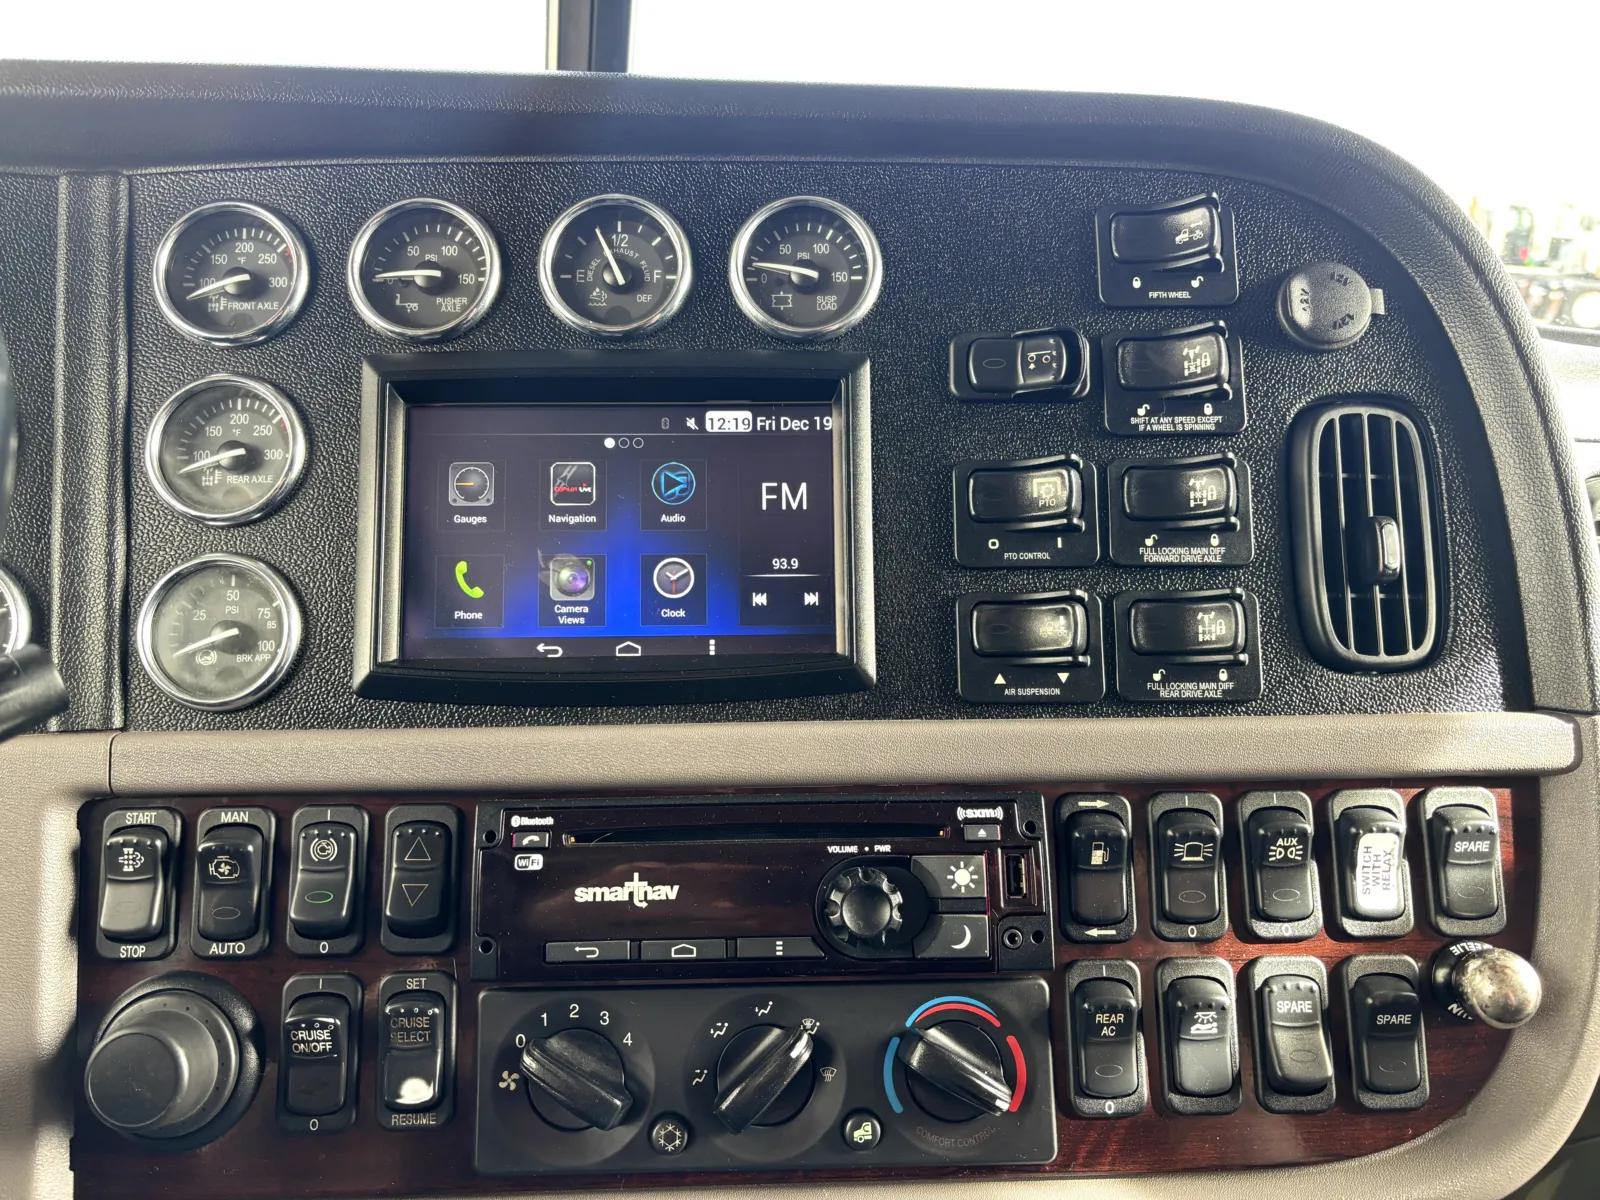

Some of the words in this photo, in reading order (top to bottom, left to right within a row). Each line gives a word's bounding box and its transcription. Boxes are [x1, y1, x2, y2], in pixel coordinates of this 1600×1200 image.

[611, 234, 628, 247] 1/2
[236, 242, 254, 253] 200
[408, 246, 420, 256] 50
[441, 246, 458, 256] 100
[779, 244, 791, 254] 50
[813, 243, 830, 254] 100
[211, 254, 227, 264] 150
[258, 254, 277, 264] 250
[587, 258, 600, 281] DIESEL
[458, 274, 474, 284] 150
[576, 270, 585, 282] E
[654, 270, 662, 283] F
[761, 273, 767, 283] 0
[832, 272, 848, 282] 150
[269, 278, 287, 287] 300
[230, 414, 249, 425] 200
[708, 418, 751, 430] 12:19
[757, 417, 776, 430] Fri
[780, 417, 810, 430] Dec
[814, 417, 832, 430] 19
[205, 426, 222, 436] 150
[253, 426, 272, 436] 250
[193, 450, 210, 461] 100
[264, 450, 283, 460] 300
[252, 475, 273, 483] AXLE
[762, 482, 807, 510] FM
[1039, 499, 1056, 507] PTO
[454, 515, 487, 525] Gauges
[549, 514, 596, 524] Navigation
[661, 514, 686, 522] Audio
[772, 558, 799, 569] 93.9
[226, 590, 240, 601] 50
[226, 606, 240, 614] PSI
[257, 608, 271, 619] 75
[555, 605, 589, 613] Camera
[661, 609, 686, 618] Clock
[193, 610, 206, 620] 25
[455, 611, 483, 620] Phone
[558, 616, 585, 624] Views
[258, 640, 275, 651] 100
[126, 812, 157, 823] START
[221, 812, 248, 822] MAN
[1276, 838, 1298, 846] AUX
[1454, 841, 1490, 853] SPARE
[1362, 846, 1372, 895] SWITCH
[1372, 854, 1382, 887] WITH
[1382, 850, 1393, 891] RELAY
[574, 872, 680, 908] smartnav
[120, 946, 146, 958] STOP
[209, 942, 246, 955] AUTO
[406, 978, 426, 989] SET
[570, 1004, 579, 1018] 2
[1277, 1001, 1312, 1013] SPARE
[390, 1017, 430, 1029] CRUISE
[540, 1012, 548, 1026] 1
[600, 1011, 610, 1025] 3
[1096, 1014, 1124, 1024] REAR
[1376, 1015, 1412, 1025] SPARE
[291, 1030, 331, 1040] CRUISE
[1101, 1026, 1116, 1036] AC
[390, 1031, 431, 1043] SELECT
[516, 1034, 526, 1048] 0
[623, 1032, 632, 1046] 4
[292, 1042, 333, 1053] ON/OFF
[391, 1113, 436, 1126] RESUME
[916, 1126, 956, 1148] COMFORT
